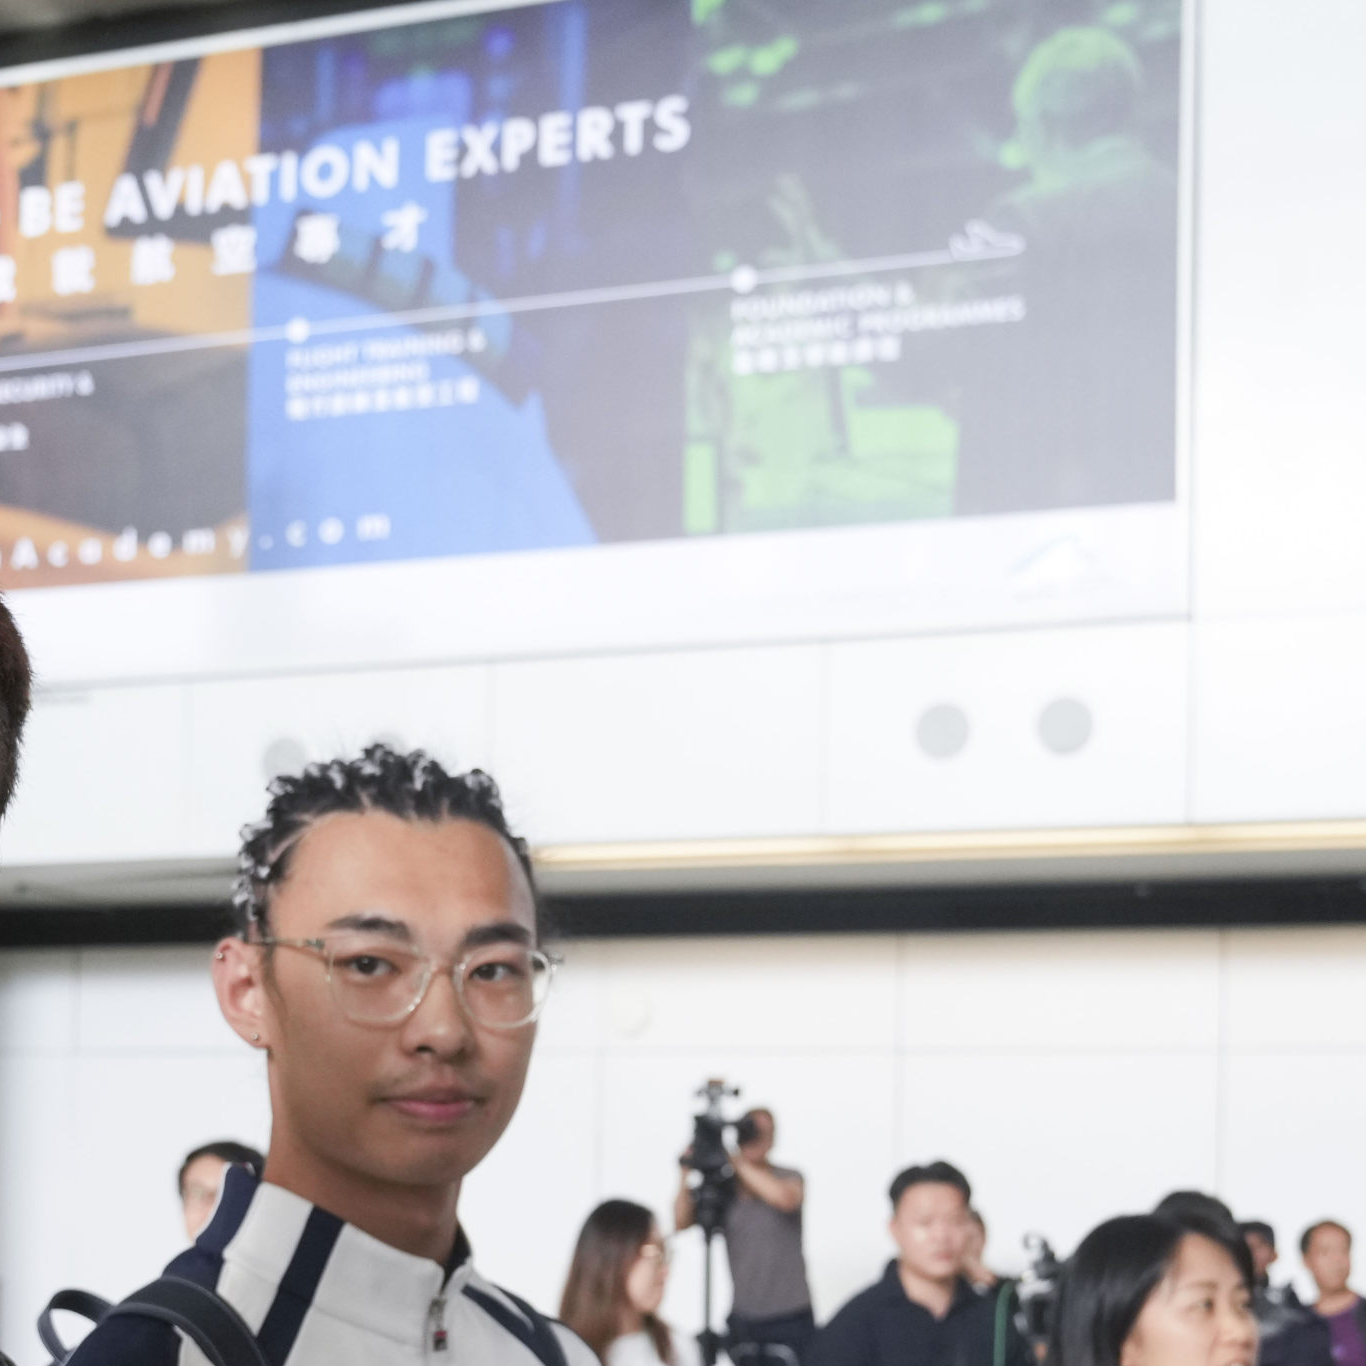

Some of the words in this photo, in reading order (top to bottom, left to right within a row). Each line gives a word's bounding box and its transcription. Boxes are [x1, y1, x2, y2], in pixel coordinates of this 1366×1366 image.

[19, 181, 85, 239] BE
[106, 139, 399, 227] AVIATION
[425, 96, 691, 184] EXPERTS
